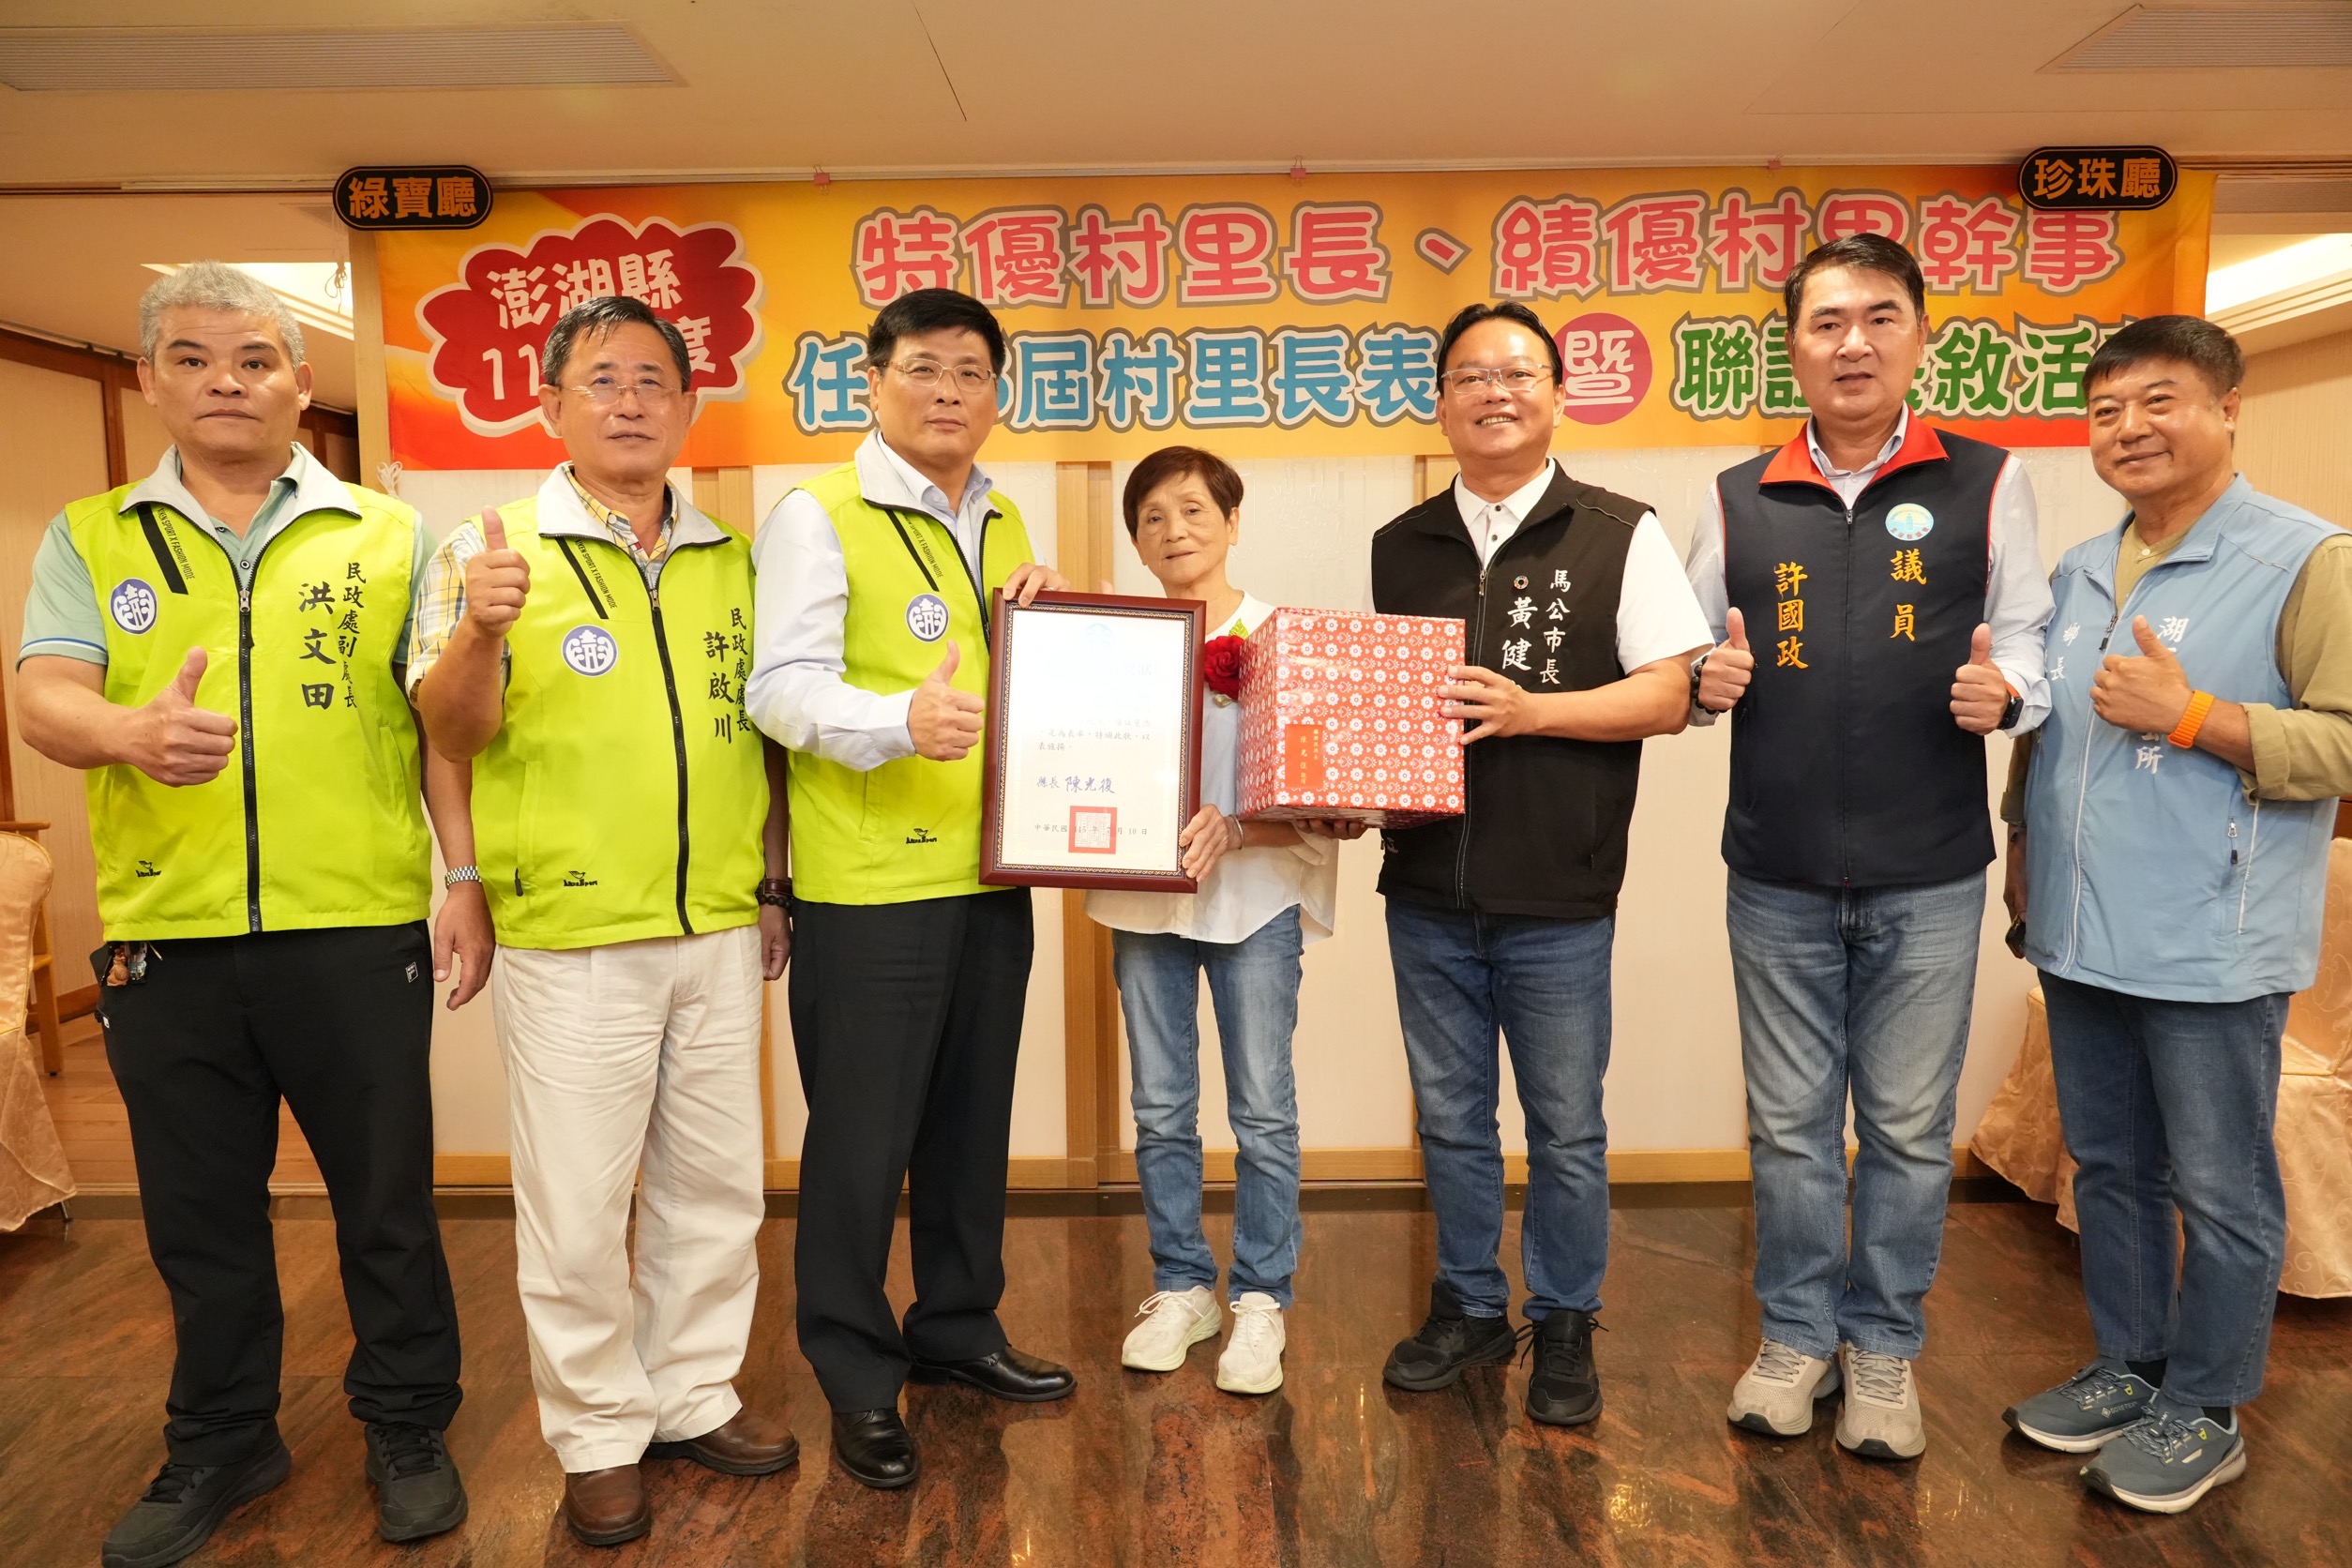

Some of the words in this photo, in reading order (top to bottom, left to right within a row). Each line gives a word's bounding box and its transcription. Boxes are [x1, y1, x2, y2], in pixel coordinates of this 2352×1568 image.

[348, 175, 478, 219] 綠寶廳
[2034, 158, 2161, 199] 珍珠廳
[486, 249, 684, 329] 澎湖縣
[1562, 329, 1639, 406] 暨
[1540, 569, 1571, 685] 馬公市長
[1773, 562, 1809, 670] 許國政
[1890, 549, 1927, 641] 議員
[298, 581, 337, 711] 洪文田
[703, 631, 735, 744] 許啟川
[731, 608, 751, 731] 民政處處長
[1502, 596, 1538, 689] 黃健
